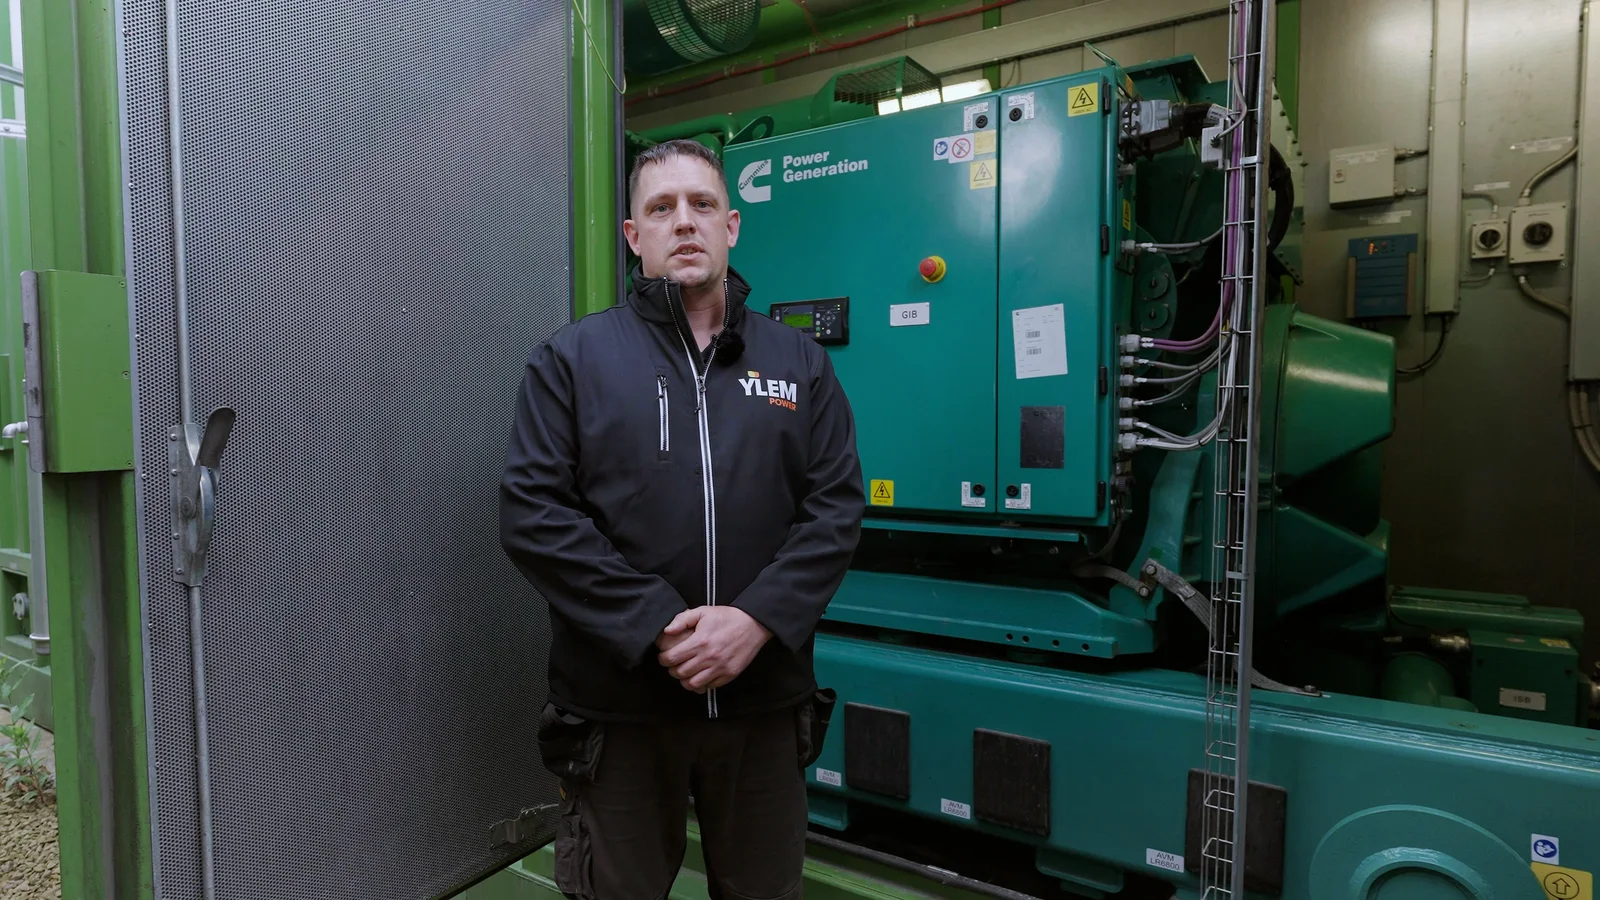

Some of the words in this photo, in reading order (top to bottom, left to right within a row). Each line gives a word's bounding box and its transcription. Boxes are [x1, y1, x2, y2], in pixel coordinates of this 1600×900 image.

[783, 151, 830, 169] Power
[738, 160, 769, 190] Cummins
[783, 159, 868, 183] Generation
[901, 310, 918, 319] GIB
[738, 378, 797, 403] YLEM
[769, 397, 797, 411] POWER
[943, 806, 967, 817] LR6800
[1156, 852, 1175, 862] AVM
[1150, 858, 1180, 871] LR6800
